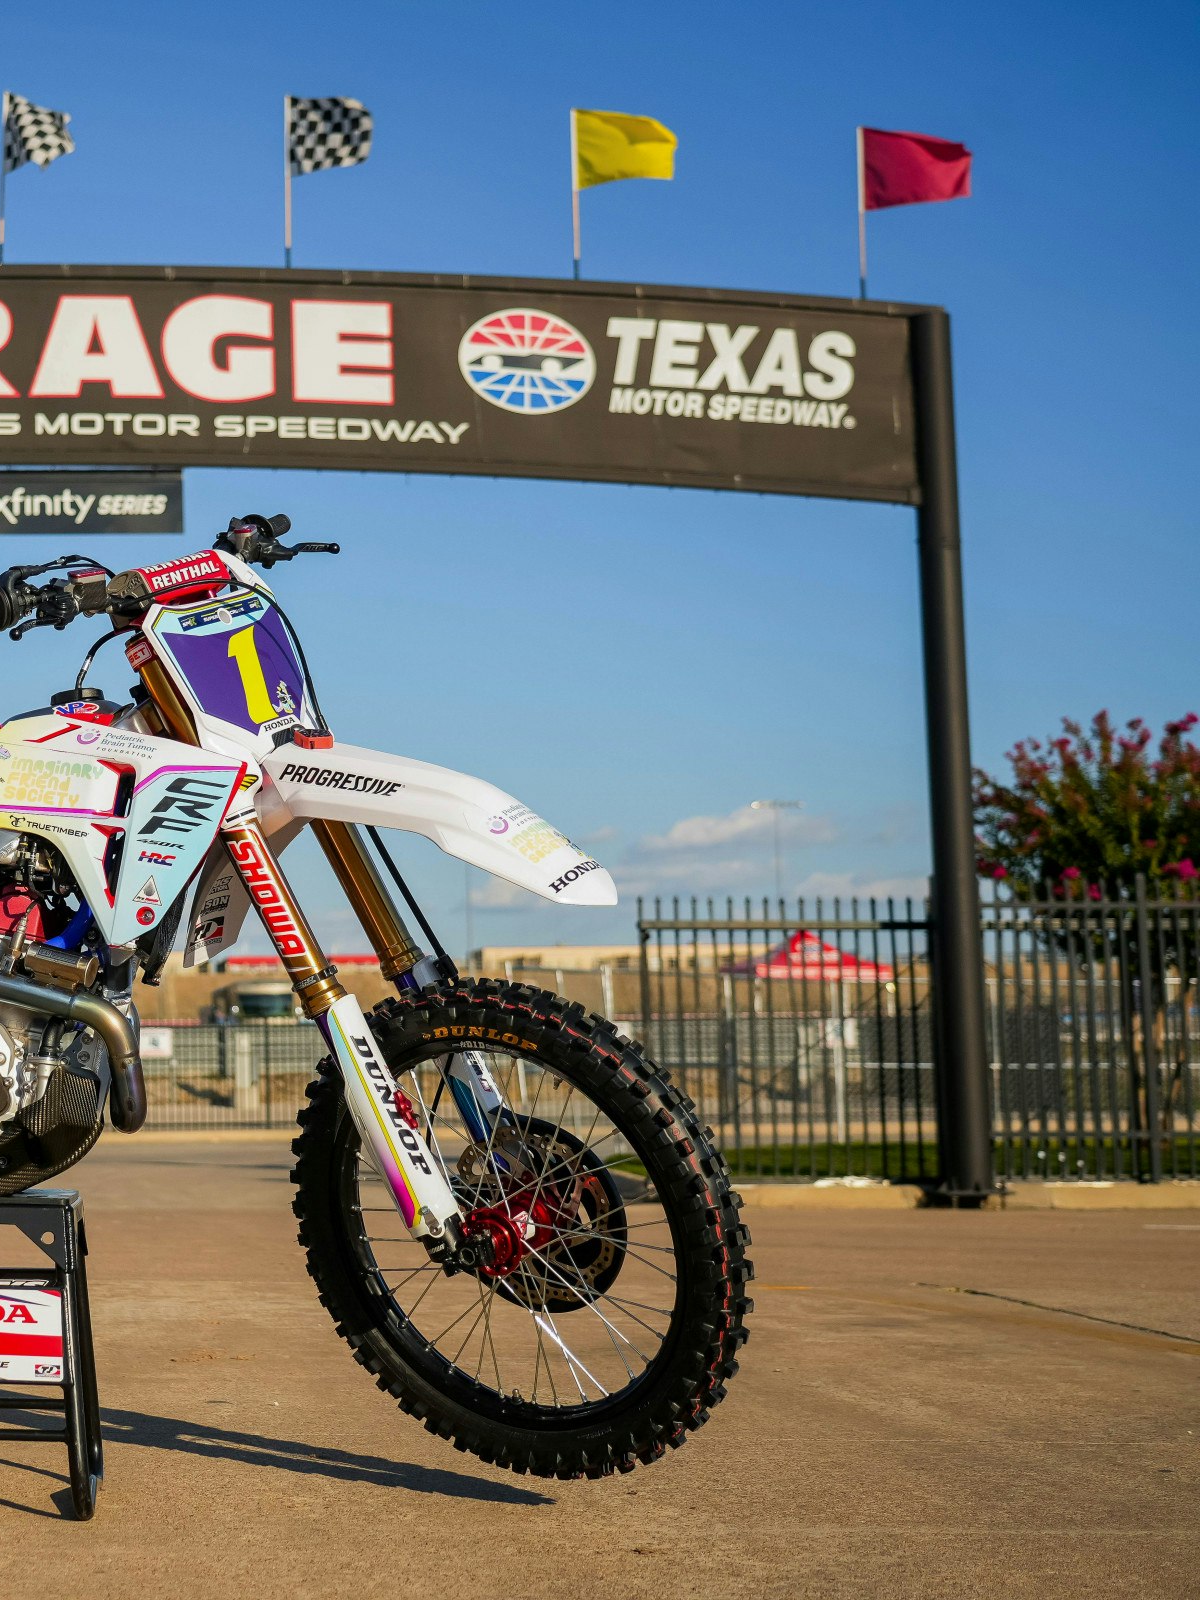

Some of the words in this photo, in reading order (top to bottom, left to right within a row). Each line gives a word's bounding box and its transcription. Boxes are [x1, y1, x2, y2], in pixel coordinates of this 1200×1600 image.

[606, 317, 856, 401] TEXAS
[608, 387, 705, 418] MOTOR
[35, 412, 199, 437] MOTOR
[214, 415, 470, 445] SPEEDWAY
[97, 494, 168, 516] SERIES
[151, 560, 220, 590] RENTHAL
[227, 625, 280, 724] 1
[105, 732, 145, 744] Pediatric
[263, 716, 296, 732] HONDA
[96, 746, 153, 760] FOUNDATION
[101, 739, 126, 748] Brain
[127, 741, 158, 752] Tumor
[279, 763, 402, 797] PROGRESSIVE
[137, 777, 229, 835] CRF
[27, 820, 89, 838] TRUETIMBER
[136, 838, 187, 851] 450R
[137, 850, 177, 867] HRC
[227, 839, 307, 958] SHOWA
[433, 1025, 538, 1051] DUNLOP
[350, 1035, 433, 1176] DUNLOP
